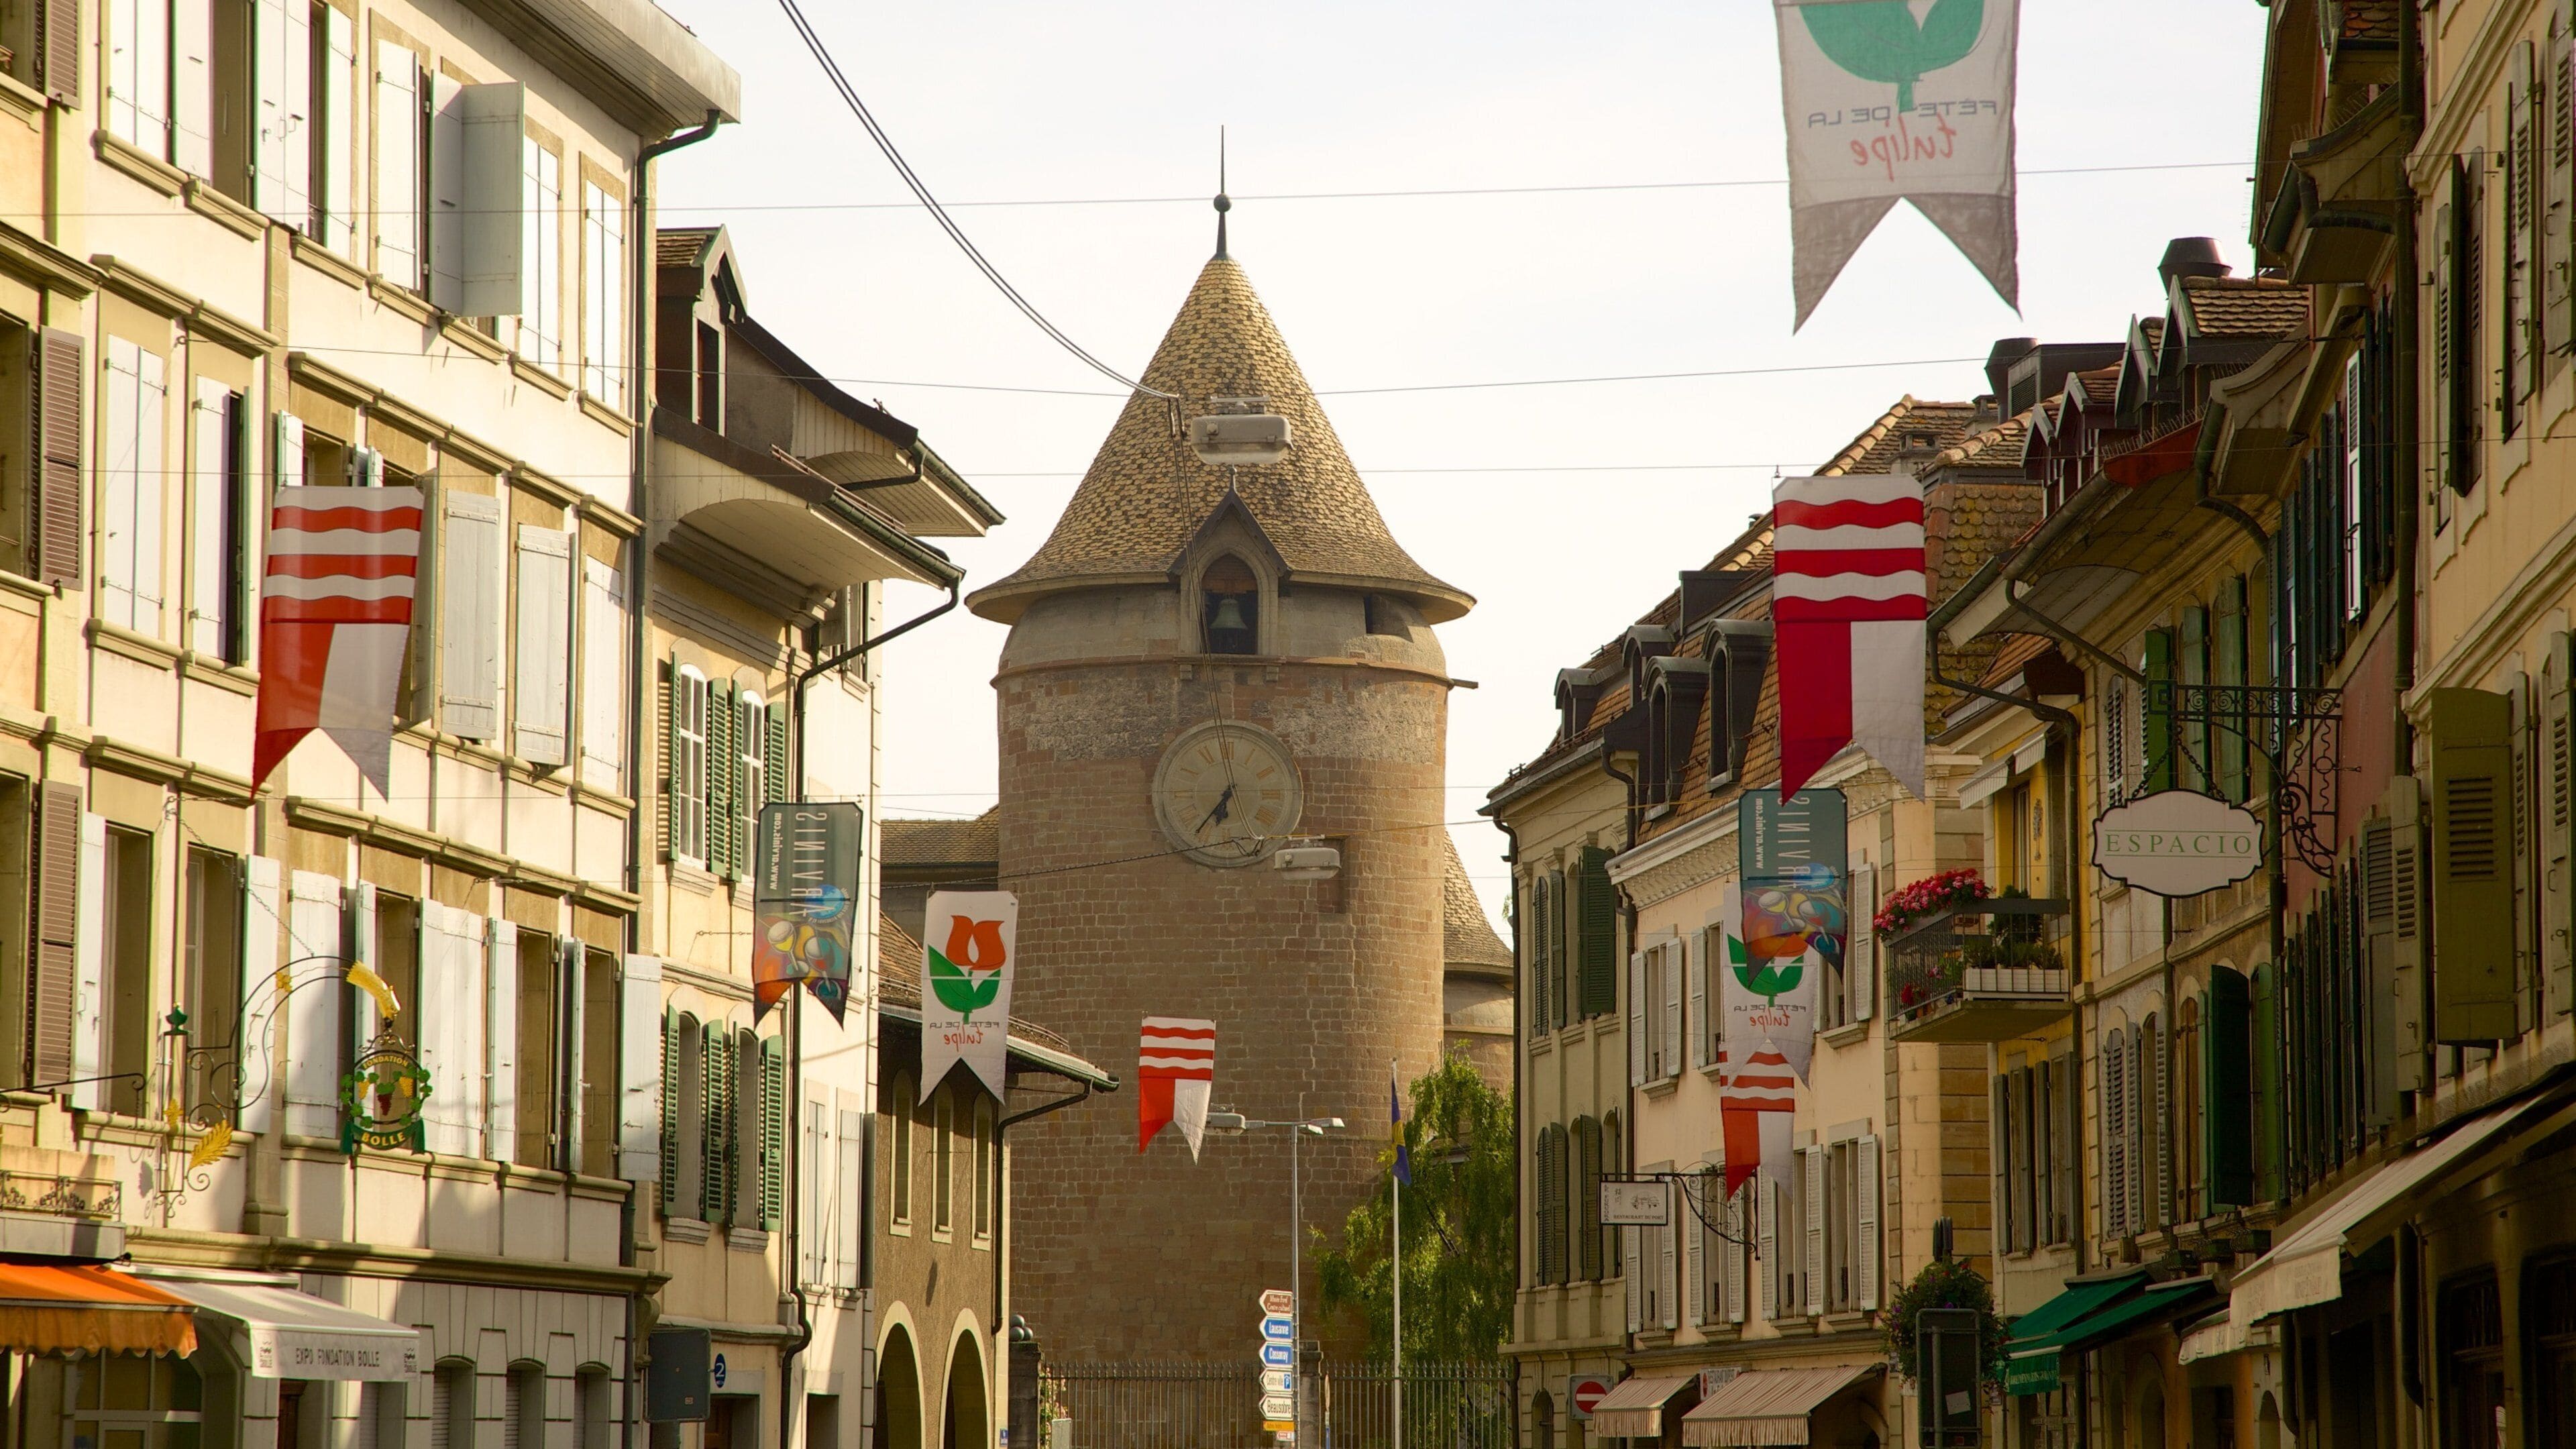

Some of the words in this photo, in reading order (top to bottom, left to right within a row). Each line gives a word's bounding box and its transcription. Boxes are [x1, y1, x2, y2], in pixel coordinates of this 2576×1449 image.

[2106, 834, 2251, 854] ESPACIO
[364, 1056, 409, 1069] FONDATION
[362, 1132, 405, 1146] BOLLE
[1269, 1322, 1289, 1335] Lausanne
[295, 1348, 313, 1364] EXPO
[317, 1349, 355, 1366] FONDATION
[358, 1350, 380, 1367] BOLLE
[1269, 1348, 1288, 1363] Cossonay
[716, 1362, 724, 1377] 2
[1267, 1400, 1291, 1414] Beausobre
